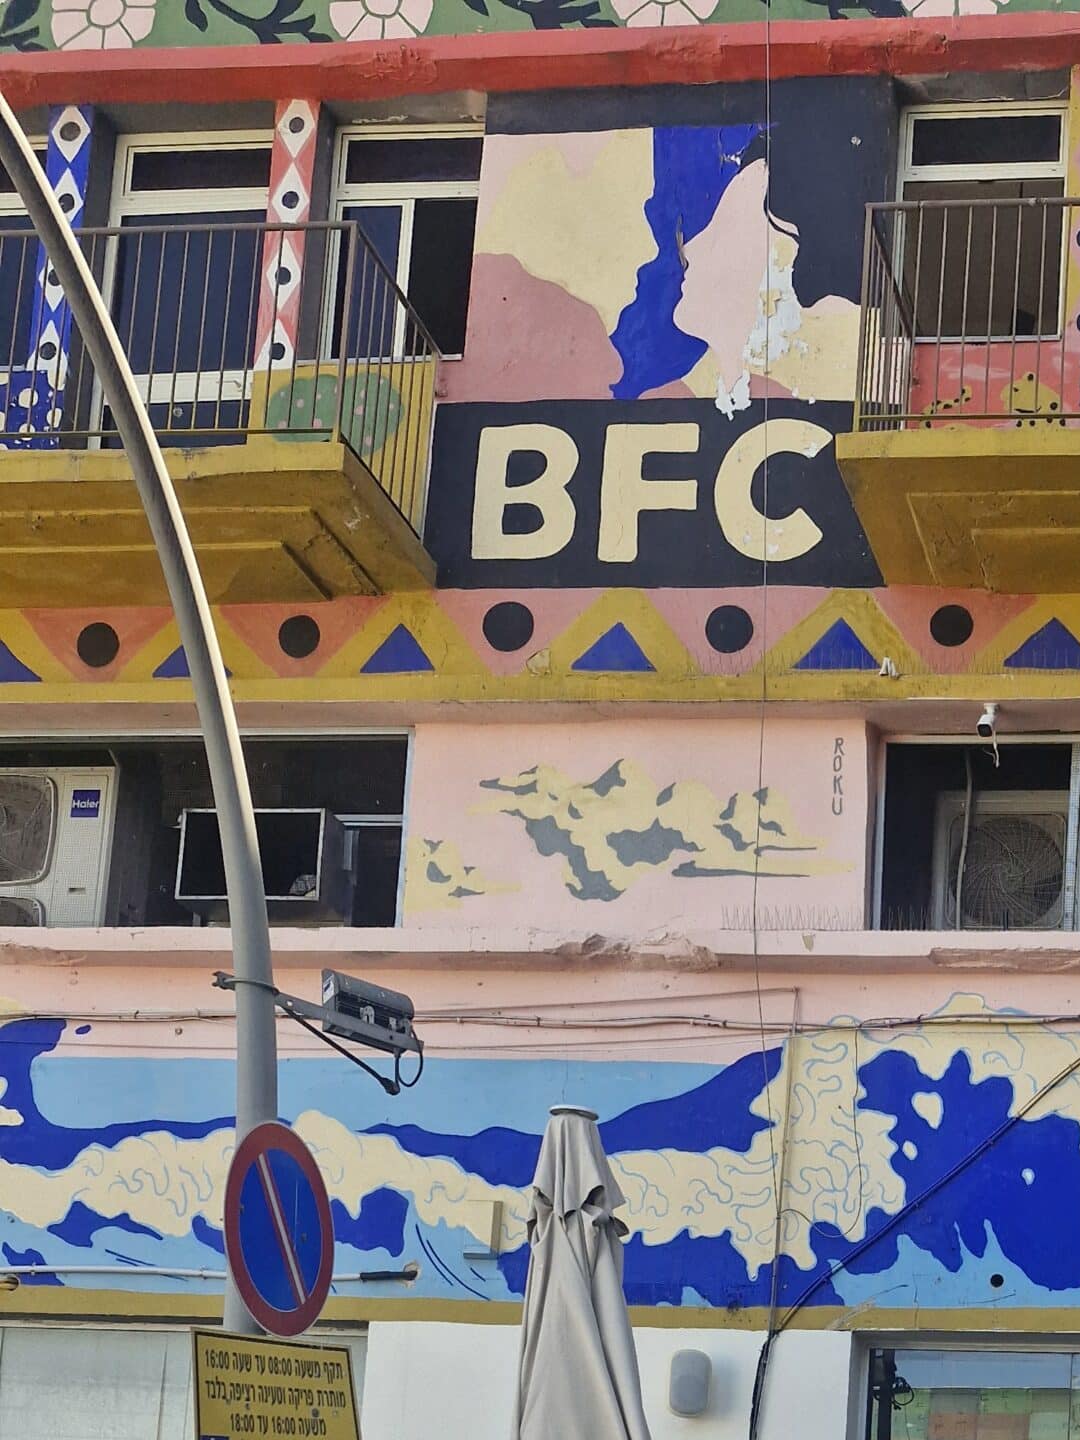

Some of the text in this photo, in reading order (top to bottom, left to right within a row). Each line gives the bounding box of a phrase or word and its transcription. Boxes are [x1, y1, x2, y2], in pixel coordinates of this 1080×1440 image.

[472, 418, 833, 562] BFC
[831, 737, 845, 816] ROKU
[72, 799, 100, 809] Haier
[205, 1349, 343, 1384] תקף משעה 08:00 עד שעה 16:00
[205, 1375, 228, 1400] בלבד
[229, 1382, 256, 1404] רציפה
[288, 1387, 314, 1410] פריקה
[317, 1389, 347, 1409] מותרת
[230, 1412, 327, 1436] משעה 16:00 עד 18:00
